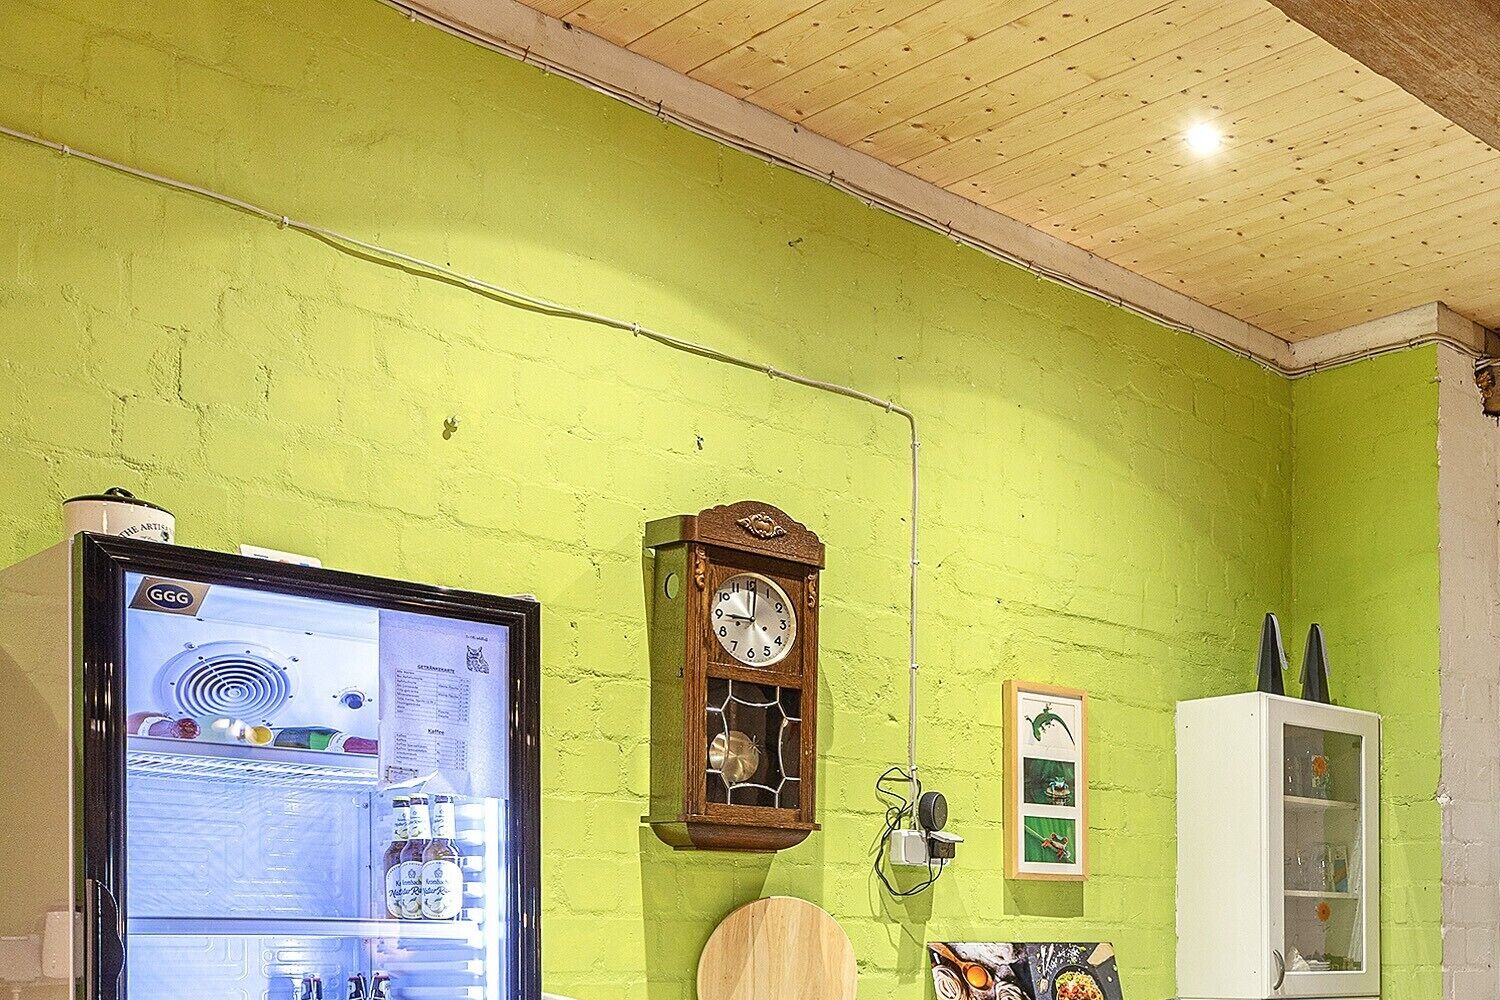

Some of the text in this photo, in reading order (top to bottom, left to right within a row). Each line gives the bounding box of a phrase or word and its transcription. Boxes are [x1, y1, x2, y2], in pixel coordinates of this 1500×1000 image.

[118, 525, 140, 539] THE
[732, 582, 740, 593] 11
[150, 589, 189, 604] GGG
[719, 592, 731, 602] 10
[775, 602, 783, 613] 2
[715, 608, 724, 619] 9
[779, 619, 787, 630] 3
[719, 626, 727, 637] 8
[730, 640, 738, 651] 7
[774, 636, 783, 646] 4
[746, 648, 755, 658] 6
[763, 646, 771, 656] 5
